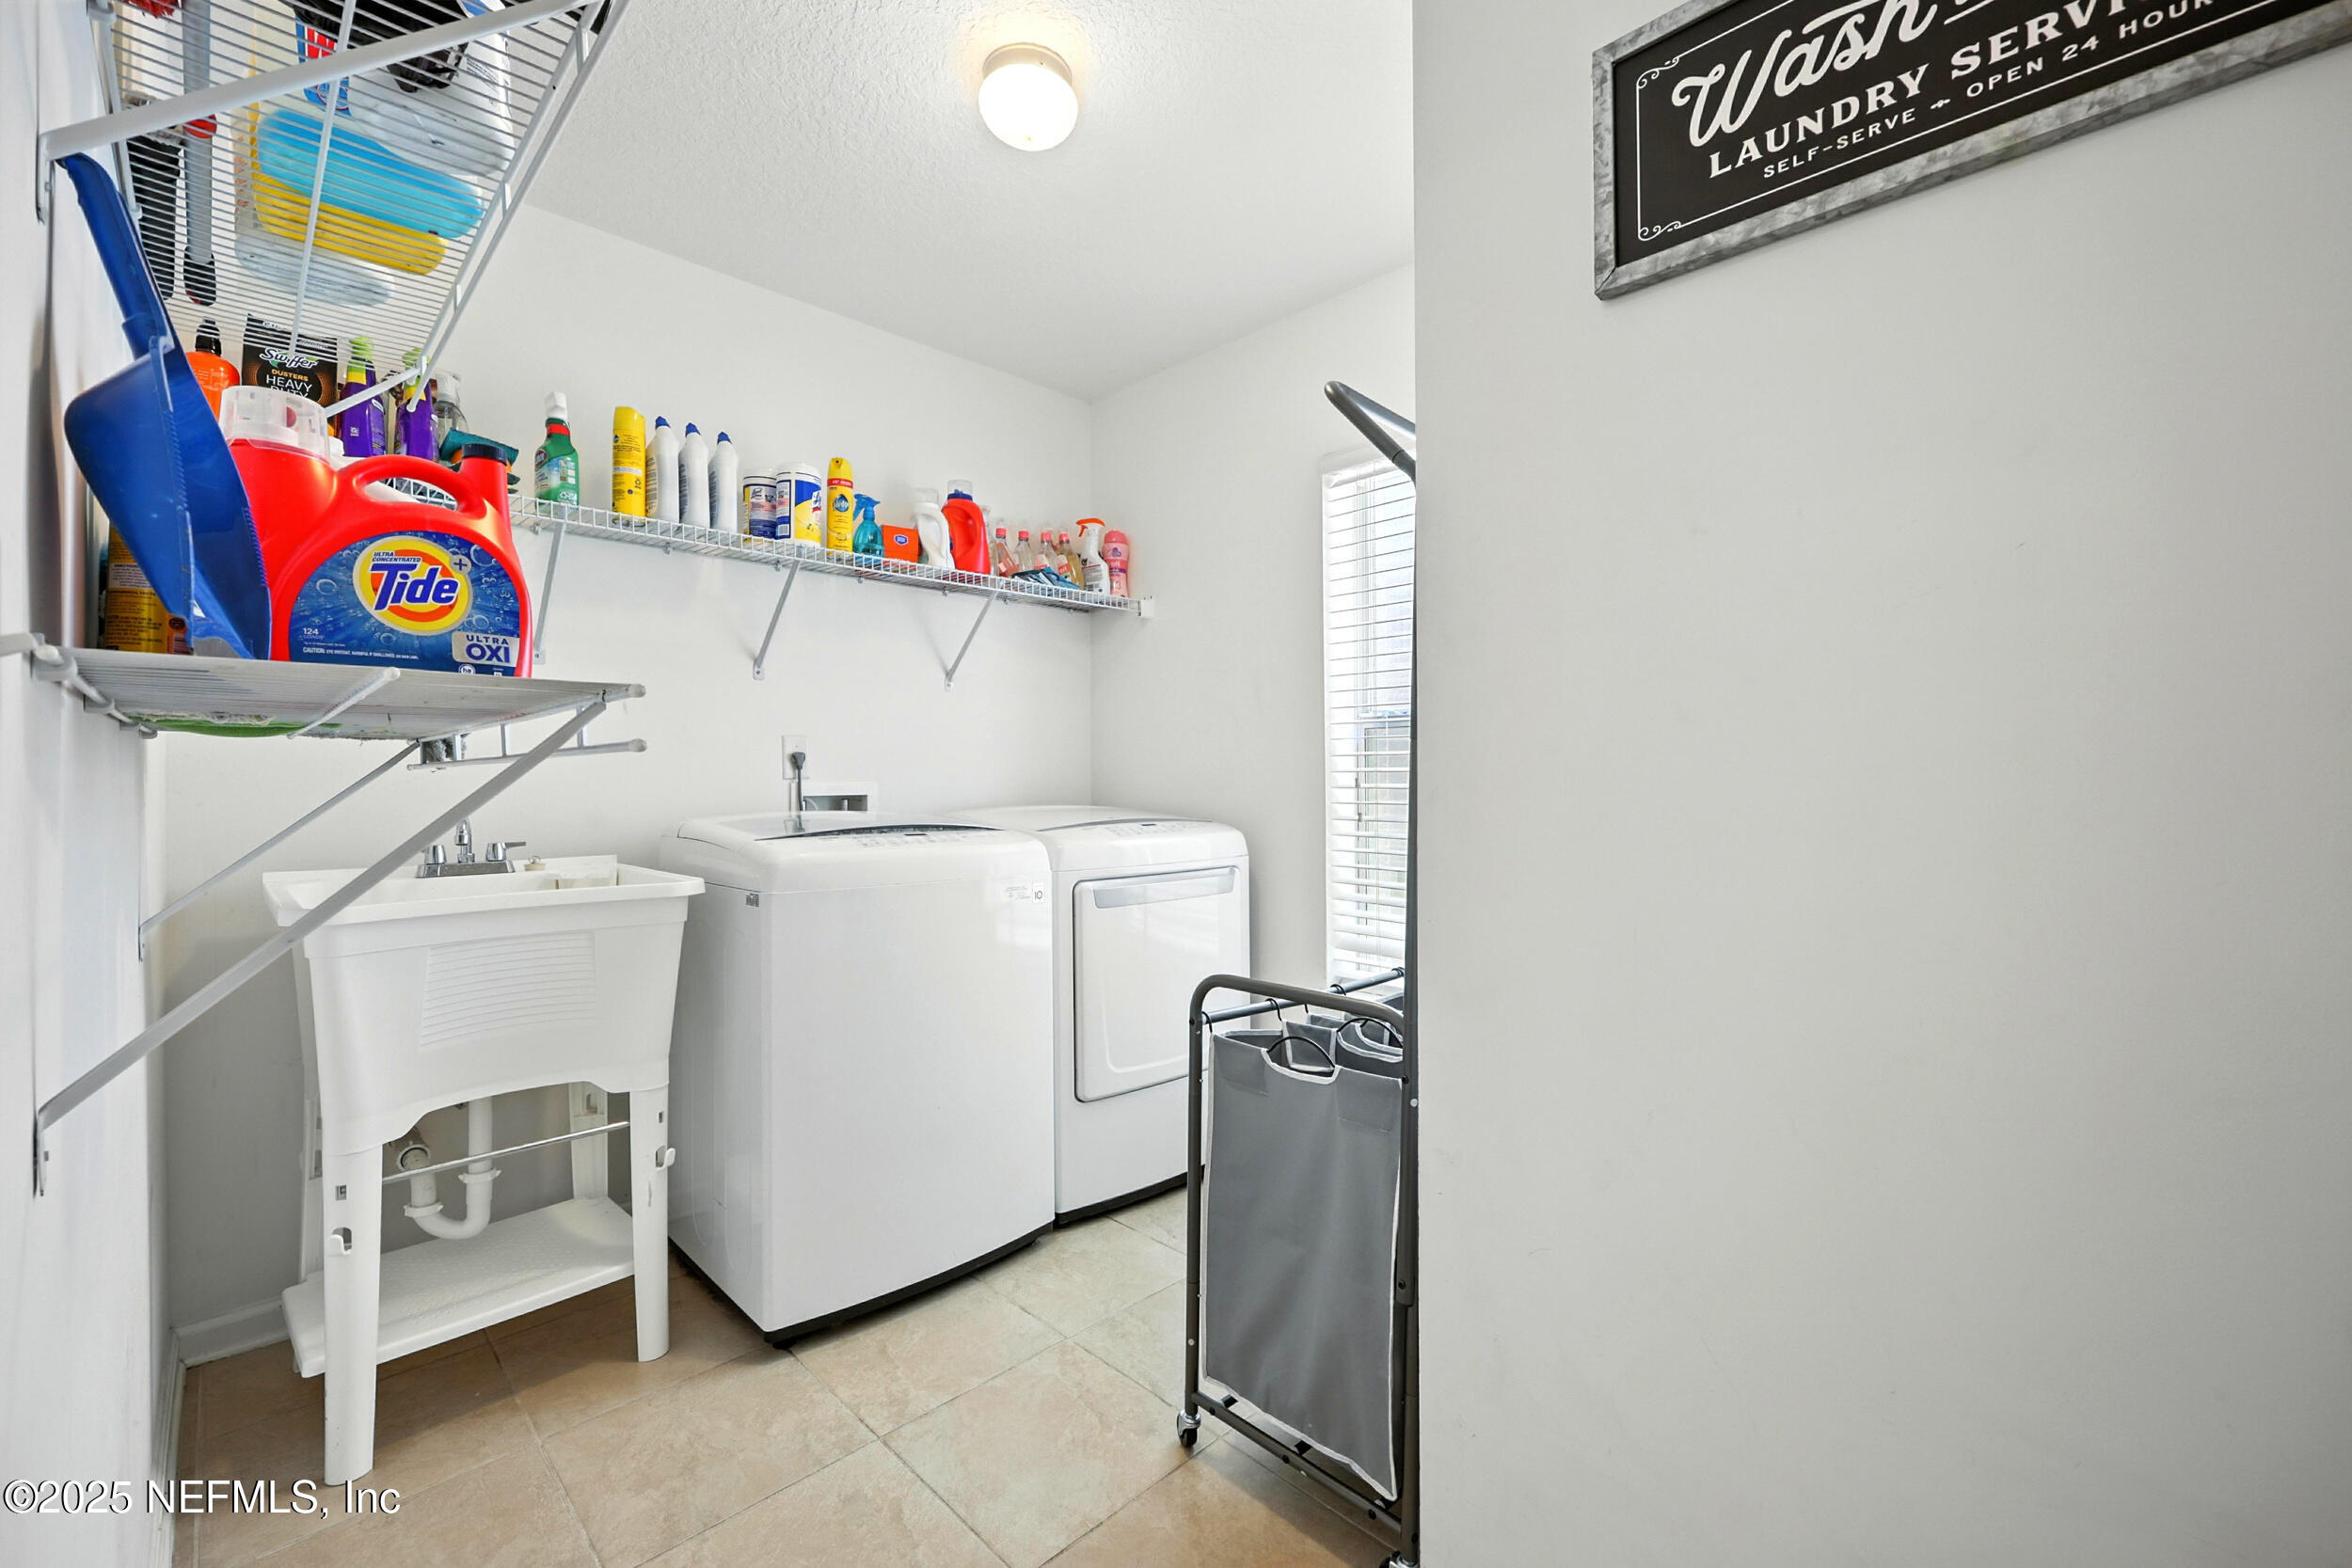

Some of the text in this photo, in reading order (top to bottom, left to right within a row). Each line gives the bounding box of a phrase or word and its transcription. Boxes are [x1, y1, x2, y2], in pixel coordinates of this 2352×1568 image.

[1709, 0, 2132, 179] LAUNDRY SERVI
[1763, 108, 1916, 179] SELF-SERVE
[1966, 56, 2043, 98] OPEN
[2061, 36, 2099, 62] 24
[259, 347, 319, 369] Swiffer
[266, 374, 313, 393] HEAVY
[271, 369, 309, 382] DUSTERS
[370, 562, 460, 611] Tide
[466, 634, 509, 645] ULTRA
[466, 642, 510, 663] OXI
